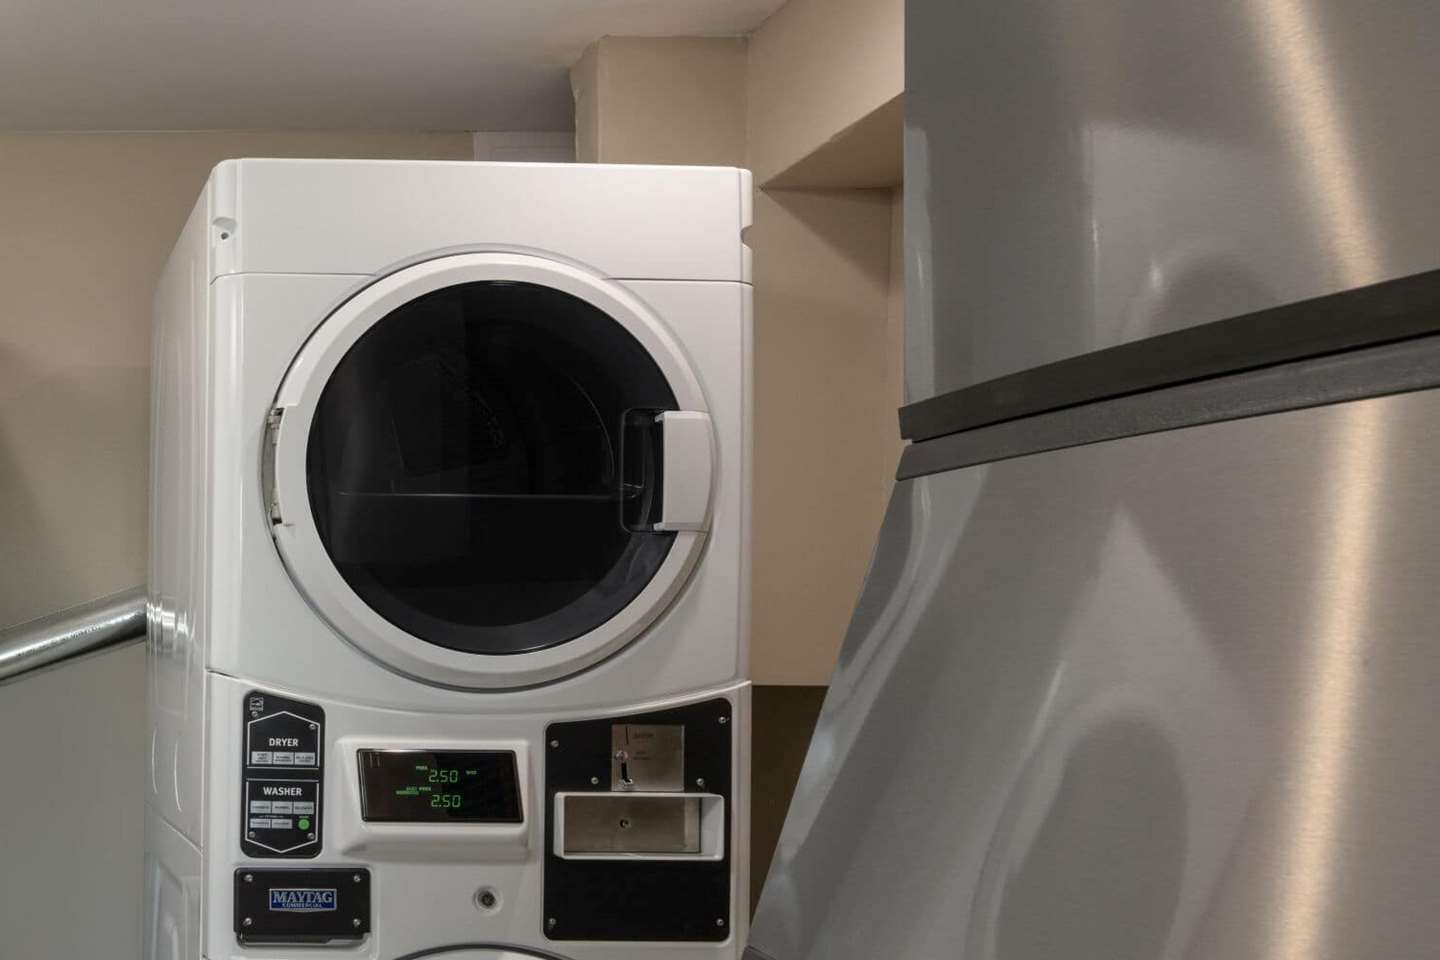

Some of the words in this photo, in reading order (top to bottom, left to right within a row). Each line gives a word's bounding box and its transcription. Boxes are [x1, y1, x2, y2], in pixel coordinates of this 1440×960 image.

[268, 737, 299, 747] DRYER
[428, 770, 459, 783] 2.50
[263, 786, 303, 796] WASHER
[431, 794, 461, 808] 2.50
[273, 891, 333, 903] MAYTAG
